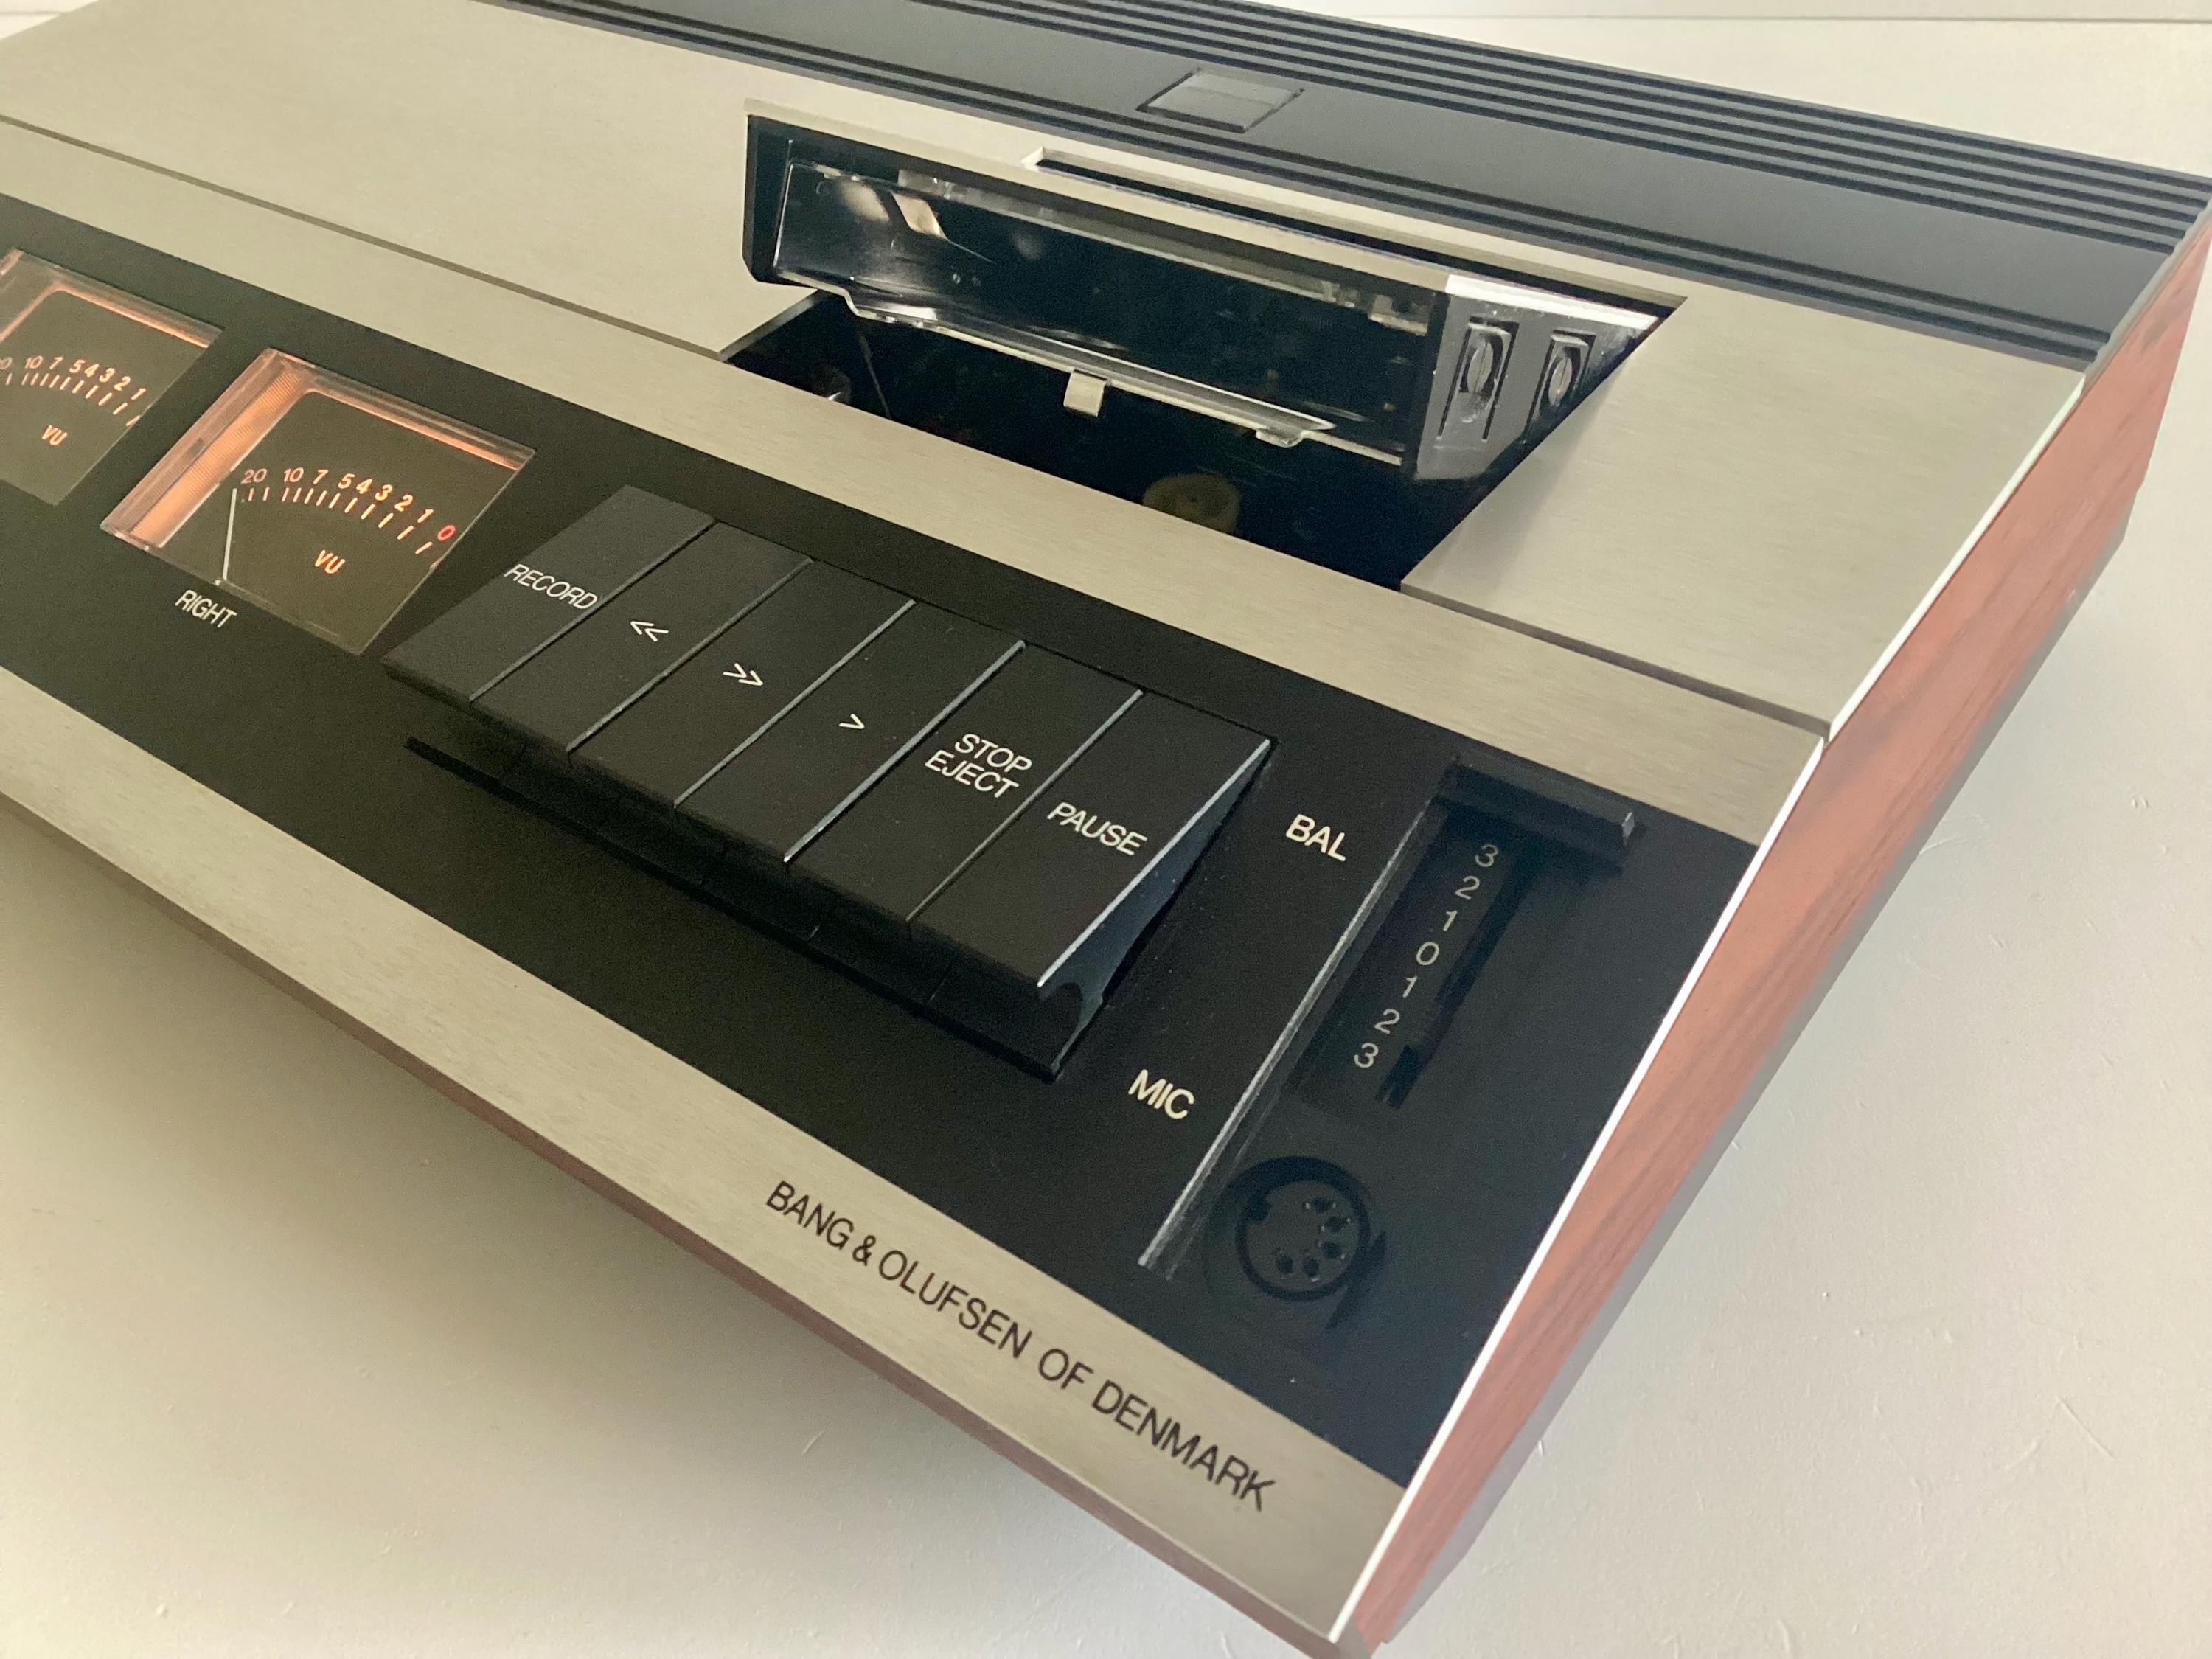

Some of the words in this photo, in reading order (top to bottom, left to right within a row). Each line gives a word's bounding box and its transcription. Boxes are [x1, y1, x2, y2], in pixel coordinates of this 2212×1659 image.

[24, 355, 44, 369] 10
[49, 356, 64, 369] 7
[69, 359, 86, 373] 5
[84, 364, 100, 378] 4
[99, 368, 115, 383] 3
[114, 376, 131, 391] 2
[131, 388, 147, 400] 1
[41, 424, 68, 445] VU
[240, 468, 268, 484] 20
[283, 467, 305, 483] 10
[313, 469, 329, 484] 7
[338, 473, 355, 490] 5
[355, 479, 373, 494] 4
[375, 484, 392, 501] 3
[394, 494, 413, 512] 2
[417, 509, 434, 524] 1
[437, 524, 456, 541] 0
[314, 549, 346, 574] VU
[504, 563, 598, 609] RECORD
[175, 589, 237, 628] RIGHT
[954, 734, 1032, 773] STOP
[925, 749, 1020, 799] EJECT
[1046, 801, 1147, 856] PAUSE
[1285, 814, 1346, 862] BAL
[1475, 844, 1499, 867] 3
[1455, 875, 1480, 900] 2
[1443, 910, 1458, 932] 1
[1416, 941, 1440, 966] 0
[1402, 976, 1418, 998] 1
[1374, 1008, 1400, 1034] 2
[1353, 1042, 1379, 1068] 3
[1128, 1068, 1195, 1119] MIC
[765, 1180, 855, 1250] BANG
[851, 1234, 877, 1265] &
[877, 1249, 1033, 1359] OLUFSEN
[1037, 1348, 1094, 1392] OF
[1091, 1379, 1277, 1512] DENMARK
